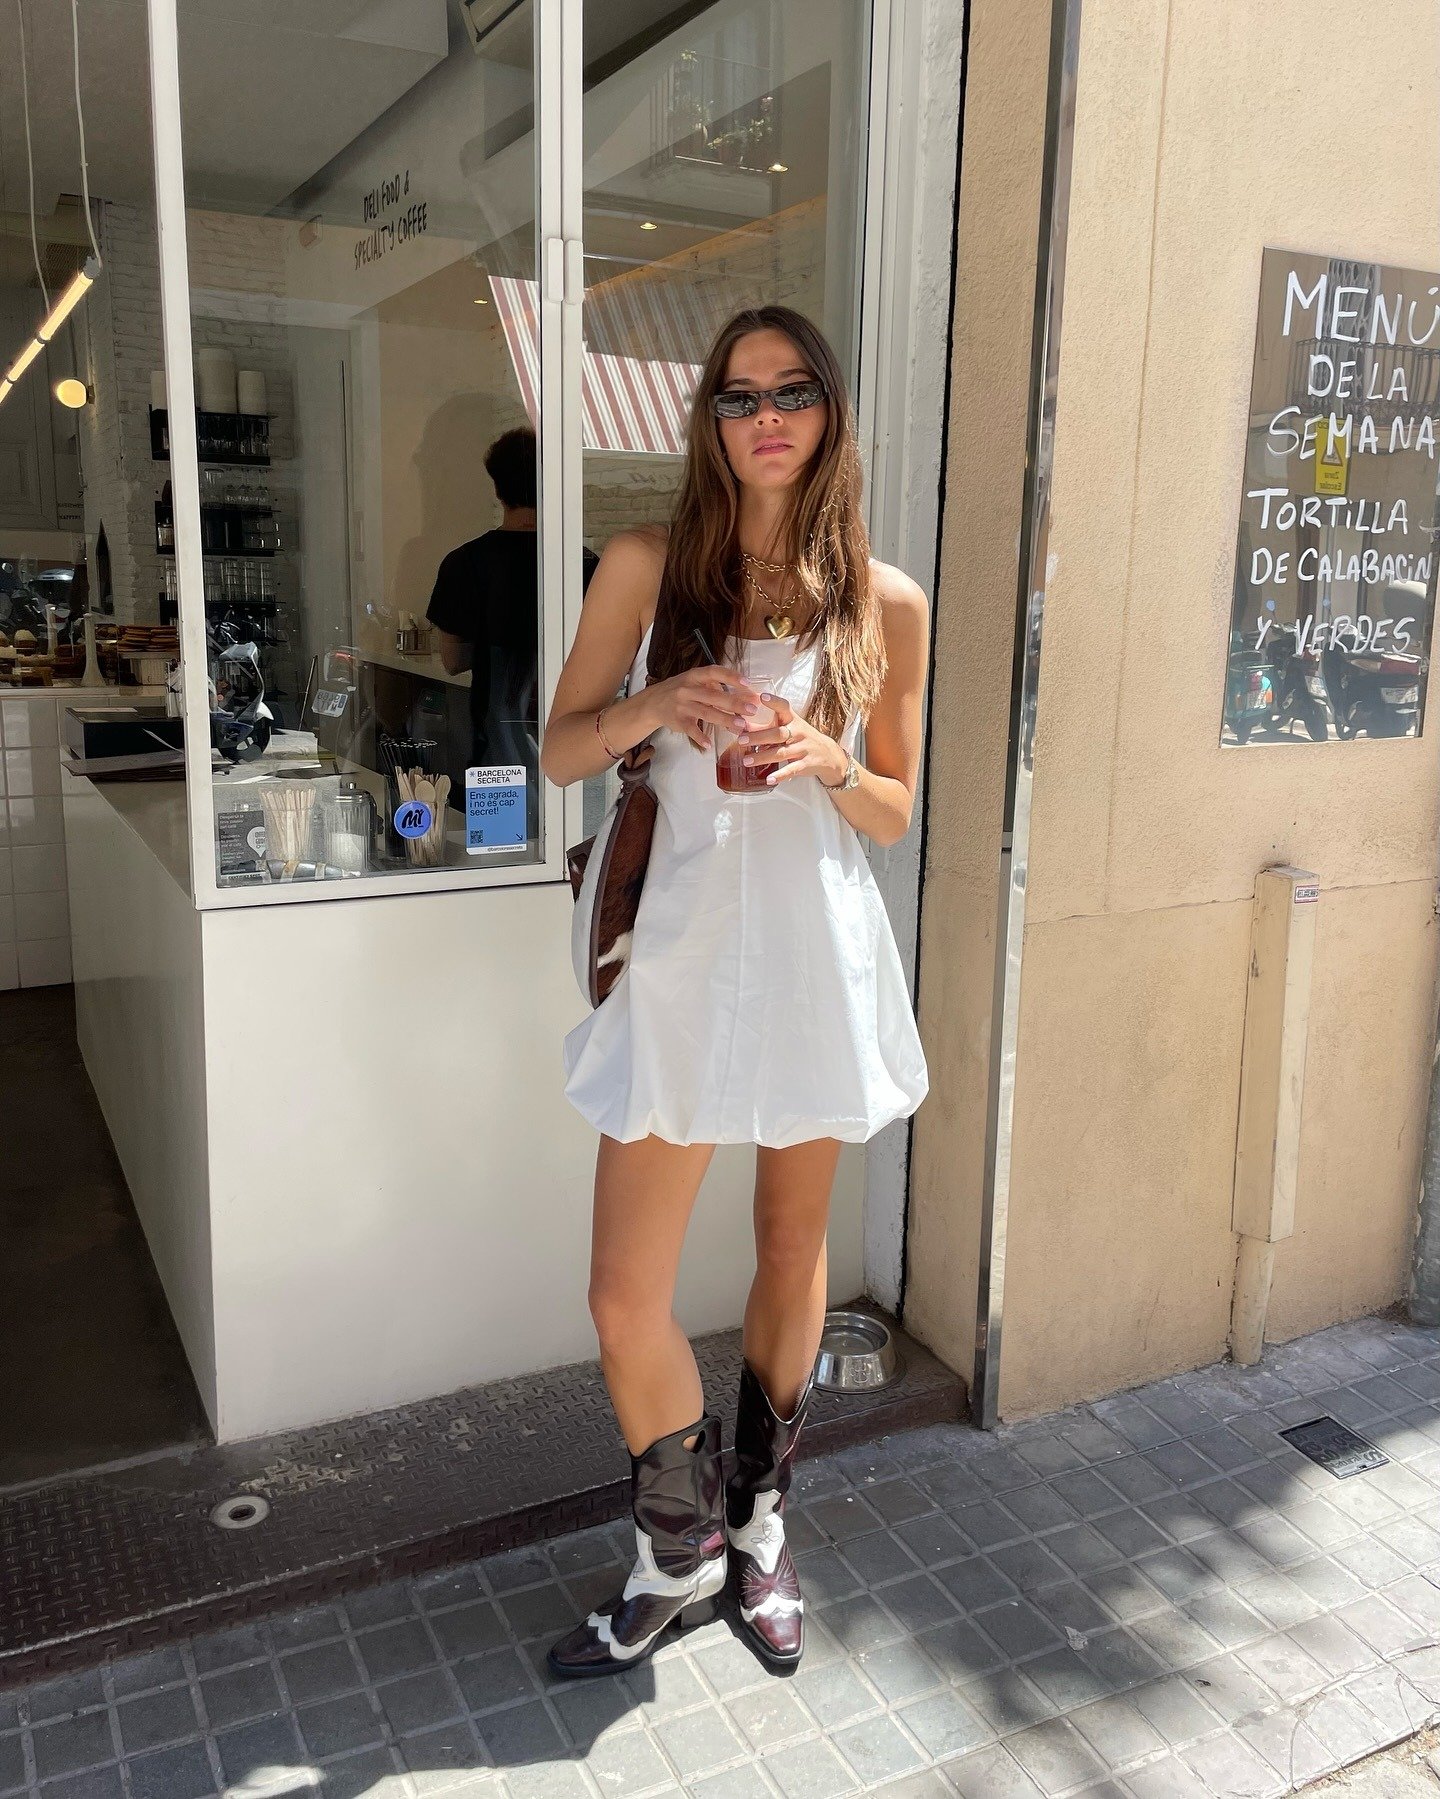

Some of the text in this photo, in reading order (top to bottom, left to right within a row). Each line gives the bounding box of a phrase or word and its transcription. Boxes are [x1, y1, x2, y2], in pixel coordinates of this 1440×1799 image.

[363, 188, 379, 223] DELI
[381, 174, 400, 212] FOOD
[354, 202, 427, 271] SPECIALTY COFFEE
[1282, 270, 1440, 345] MENÚ
[1307, 354, 1408, 402] DE LA
[1266, 405, 1440, 460] SEMANA
[1250, 547, 1290, 584] DE
[1254, 614, 1415, 655] Y VERDES
[477, 769, 522, 778] BARCELONA
[477, 776, 510, 785] SECRETA
[469, 790, 519, 800] Ens agrada,
[469, 807, 499, 816] secret!
[499, 799, 515, 808] cap
